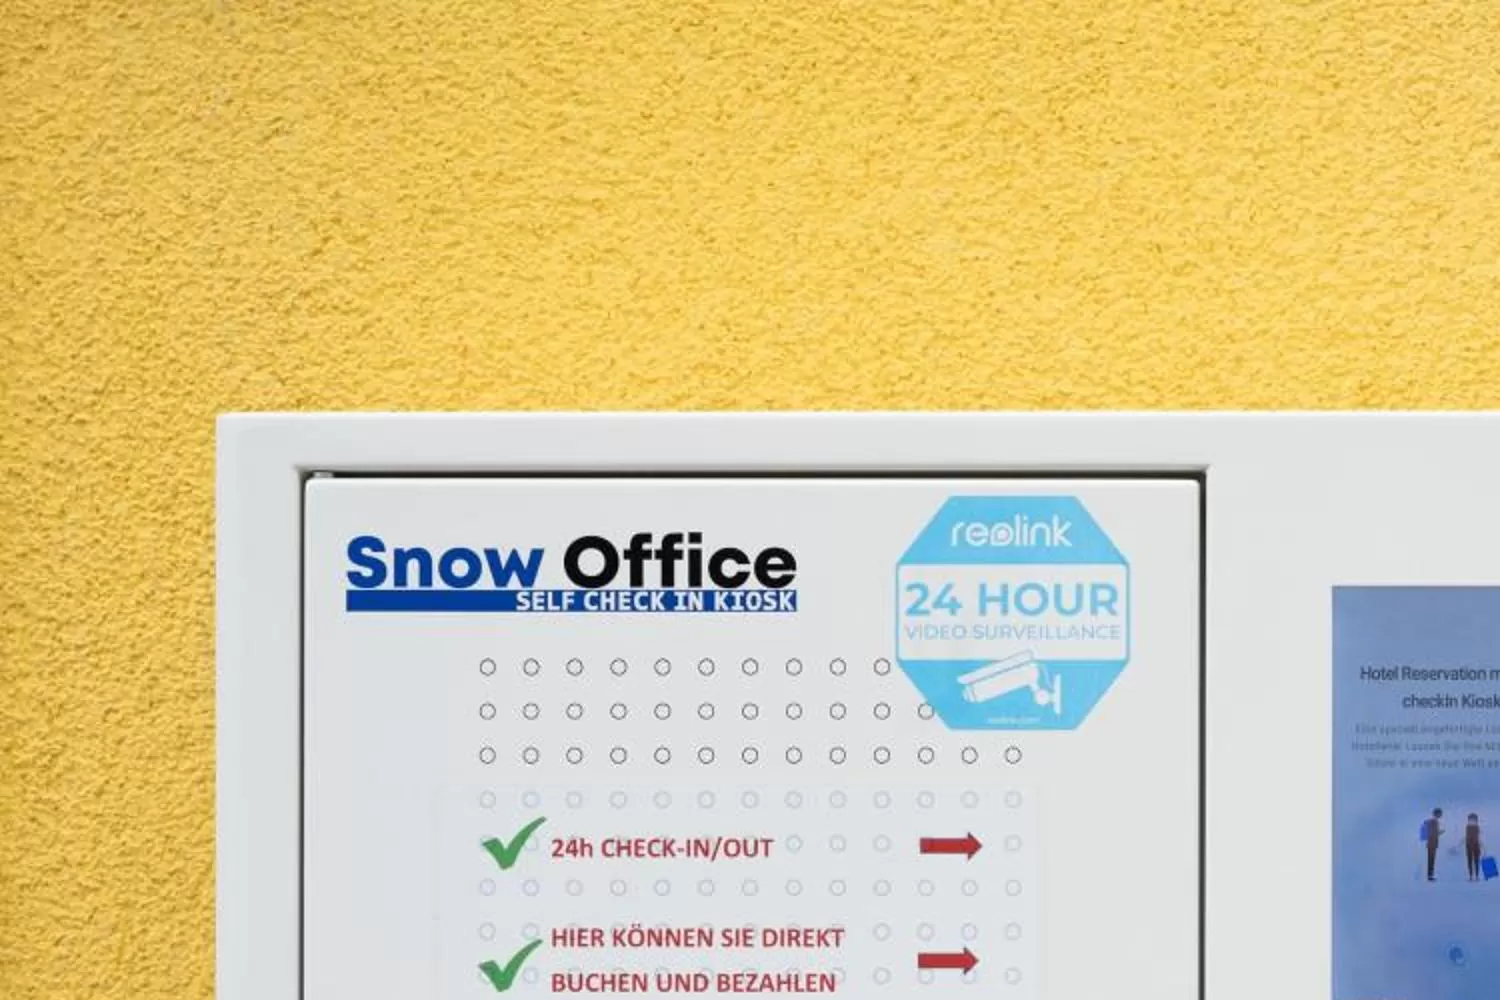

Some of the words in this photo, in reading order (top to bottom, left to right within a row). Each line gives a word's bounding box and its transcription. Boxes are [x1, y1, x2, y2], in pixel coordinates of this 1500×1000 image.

[950, 514, 1072, 547] reolink
[346, 535, 544, 590] Snow
[563, 532, 797, 590] Office
[515, 591, 576, 611] SELF
[580, 591, 668, 611] CHECK
[673, 591, 706, 611] IN
[713, 591, 796, 612] KIOSK
[904, 582, 963, 617] 24
[977, 582, 1120, 617] HOUR
[904, 624, 967, 640] VIDEO
[972, 624, 1121, 641] SURVEILLANCE
[1360, 666, 1399, 681] Hotel
[1402, 666, 1487, 681] Reservation
[552, 837, 594, 858] 24h
[601, 837, 774, 860] CHECK-IN/OUT
[551, 928, 604, 948] HIER
[612, 922, 714, 948] KÖNNEN
[721, 928, 754, 948] SIE
[761, 928, 845, 948] DIREKT
[551, 973, 648, 993] BUCHEN
[656, 973, 708, 993] UND
[716, 973, 836, 993] BEZAHLEN
